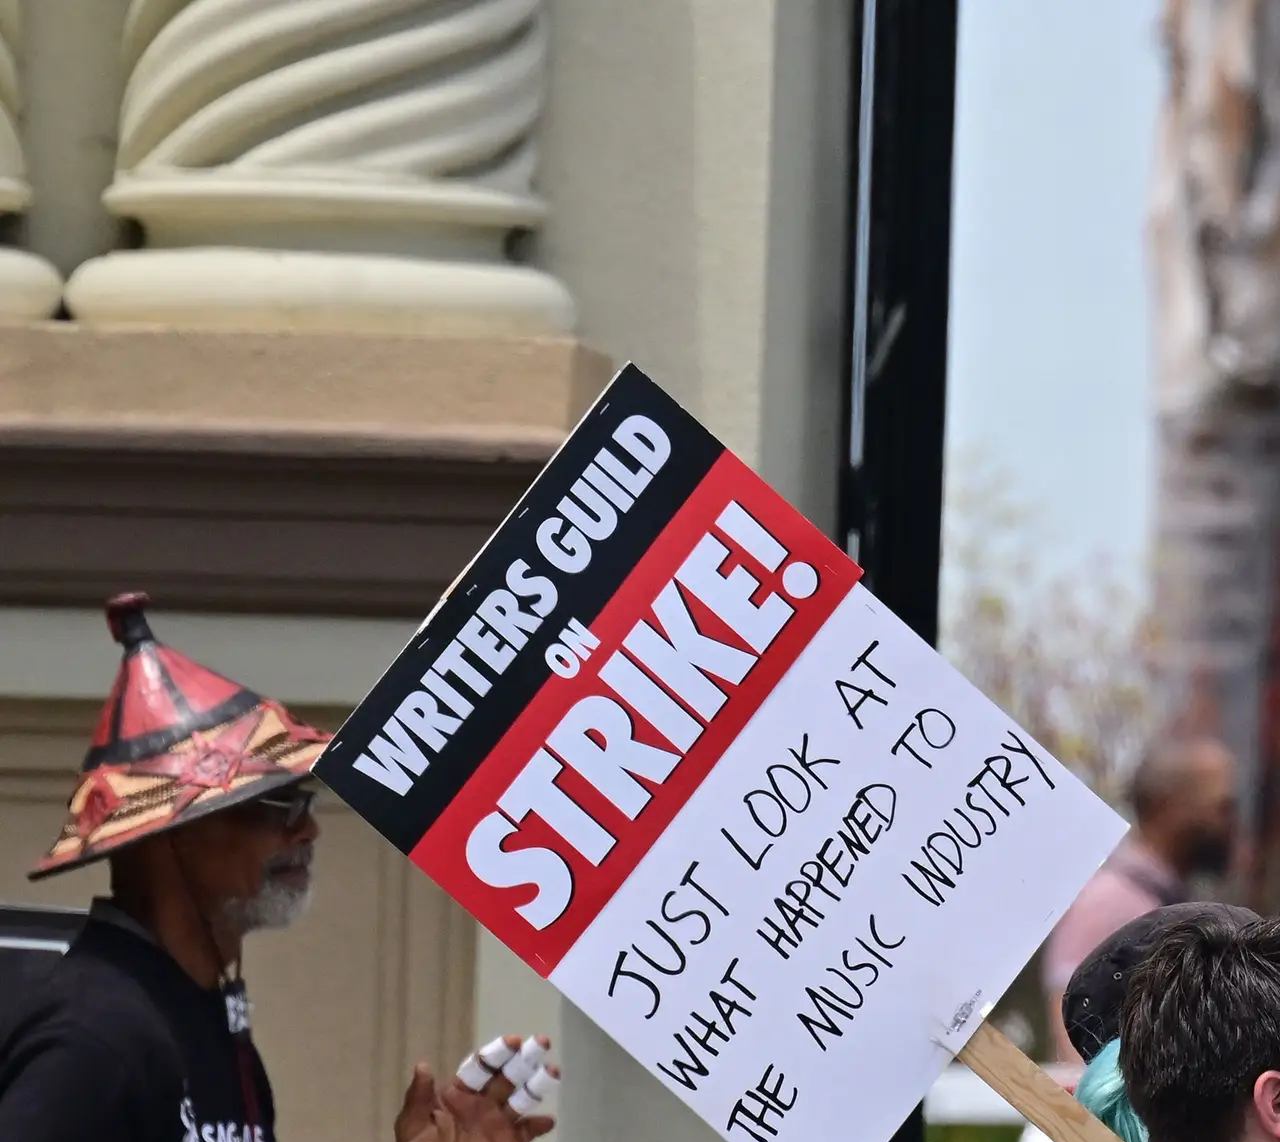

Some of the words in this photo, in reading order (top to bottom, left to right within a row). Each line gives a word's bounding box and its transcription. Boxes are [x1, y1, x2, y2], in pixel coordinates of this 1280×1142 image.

[353, 557, 559, 796] WRITERS
[536, 414, 671, 573] GUILD
[465, 500, 822, 931] STRIKE!
[546, 616, 601, 679] ON
[608, 860, 727, 1019] JUST
[720, 732, 840, 869] LOOK
[837, 641, 896, 728] AT
[657, 959, 757, 1091] WHAT
[757, 782, 898, 959] HAPPENED
[892, 707, 956, 769] TO
[796, 914, 905, 1051] MUSIC
[903, 730, 1056, 906] INDUSTRY
